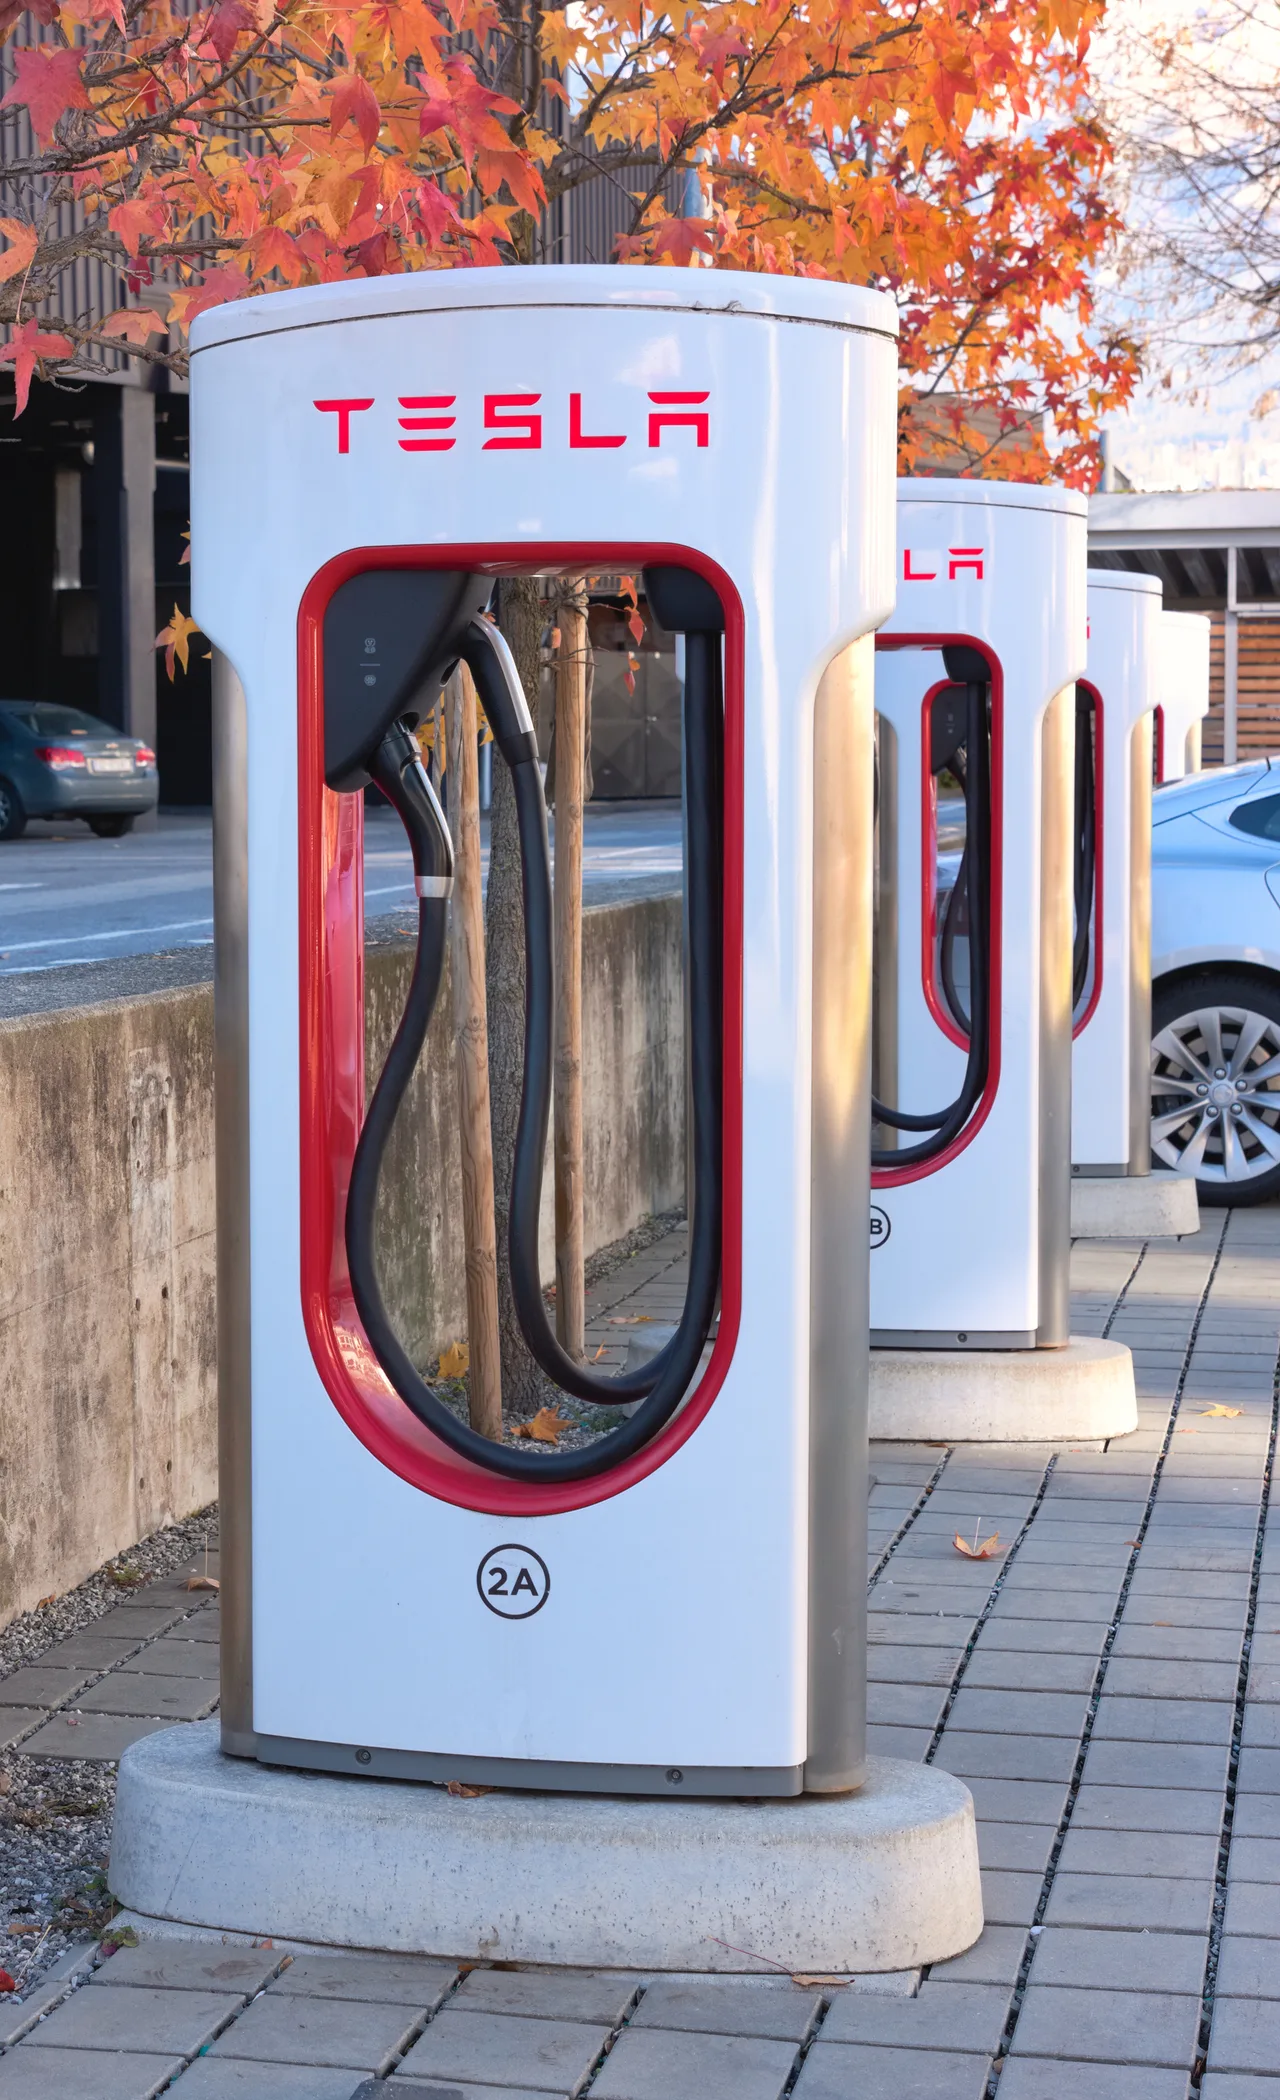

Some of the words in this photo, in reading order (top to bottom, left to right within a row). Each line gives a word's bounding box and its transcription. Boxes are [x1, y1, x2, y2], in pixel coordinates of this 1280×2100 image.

[313, 391, 710, 454] TESLA
[903, 548, 984, 580] LA
[870, 1218, 883, 1235] B
[488, 1566, 539, 1596] 2A
